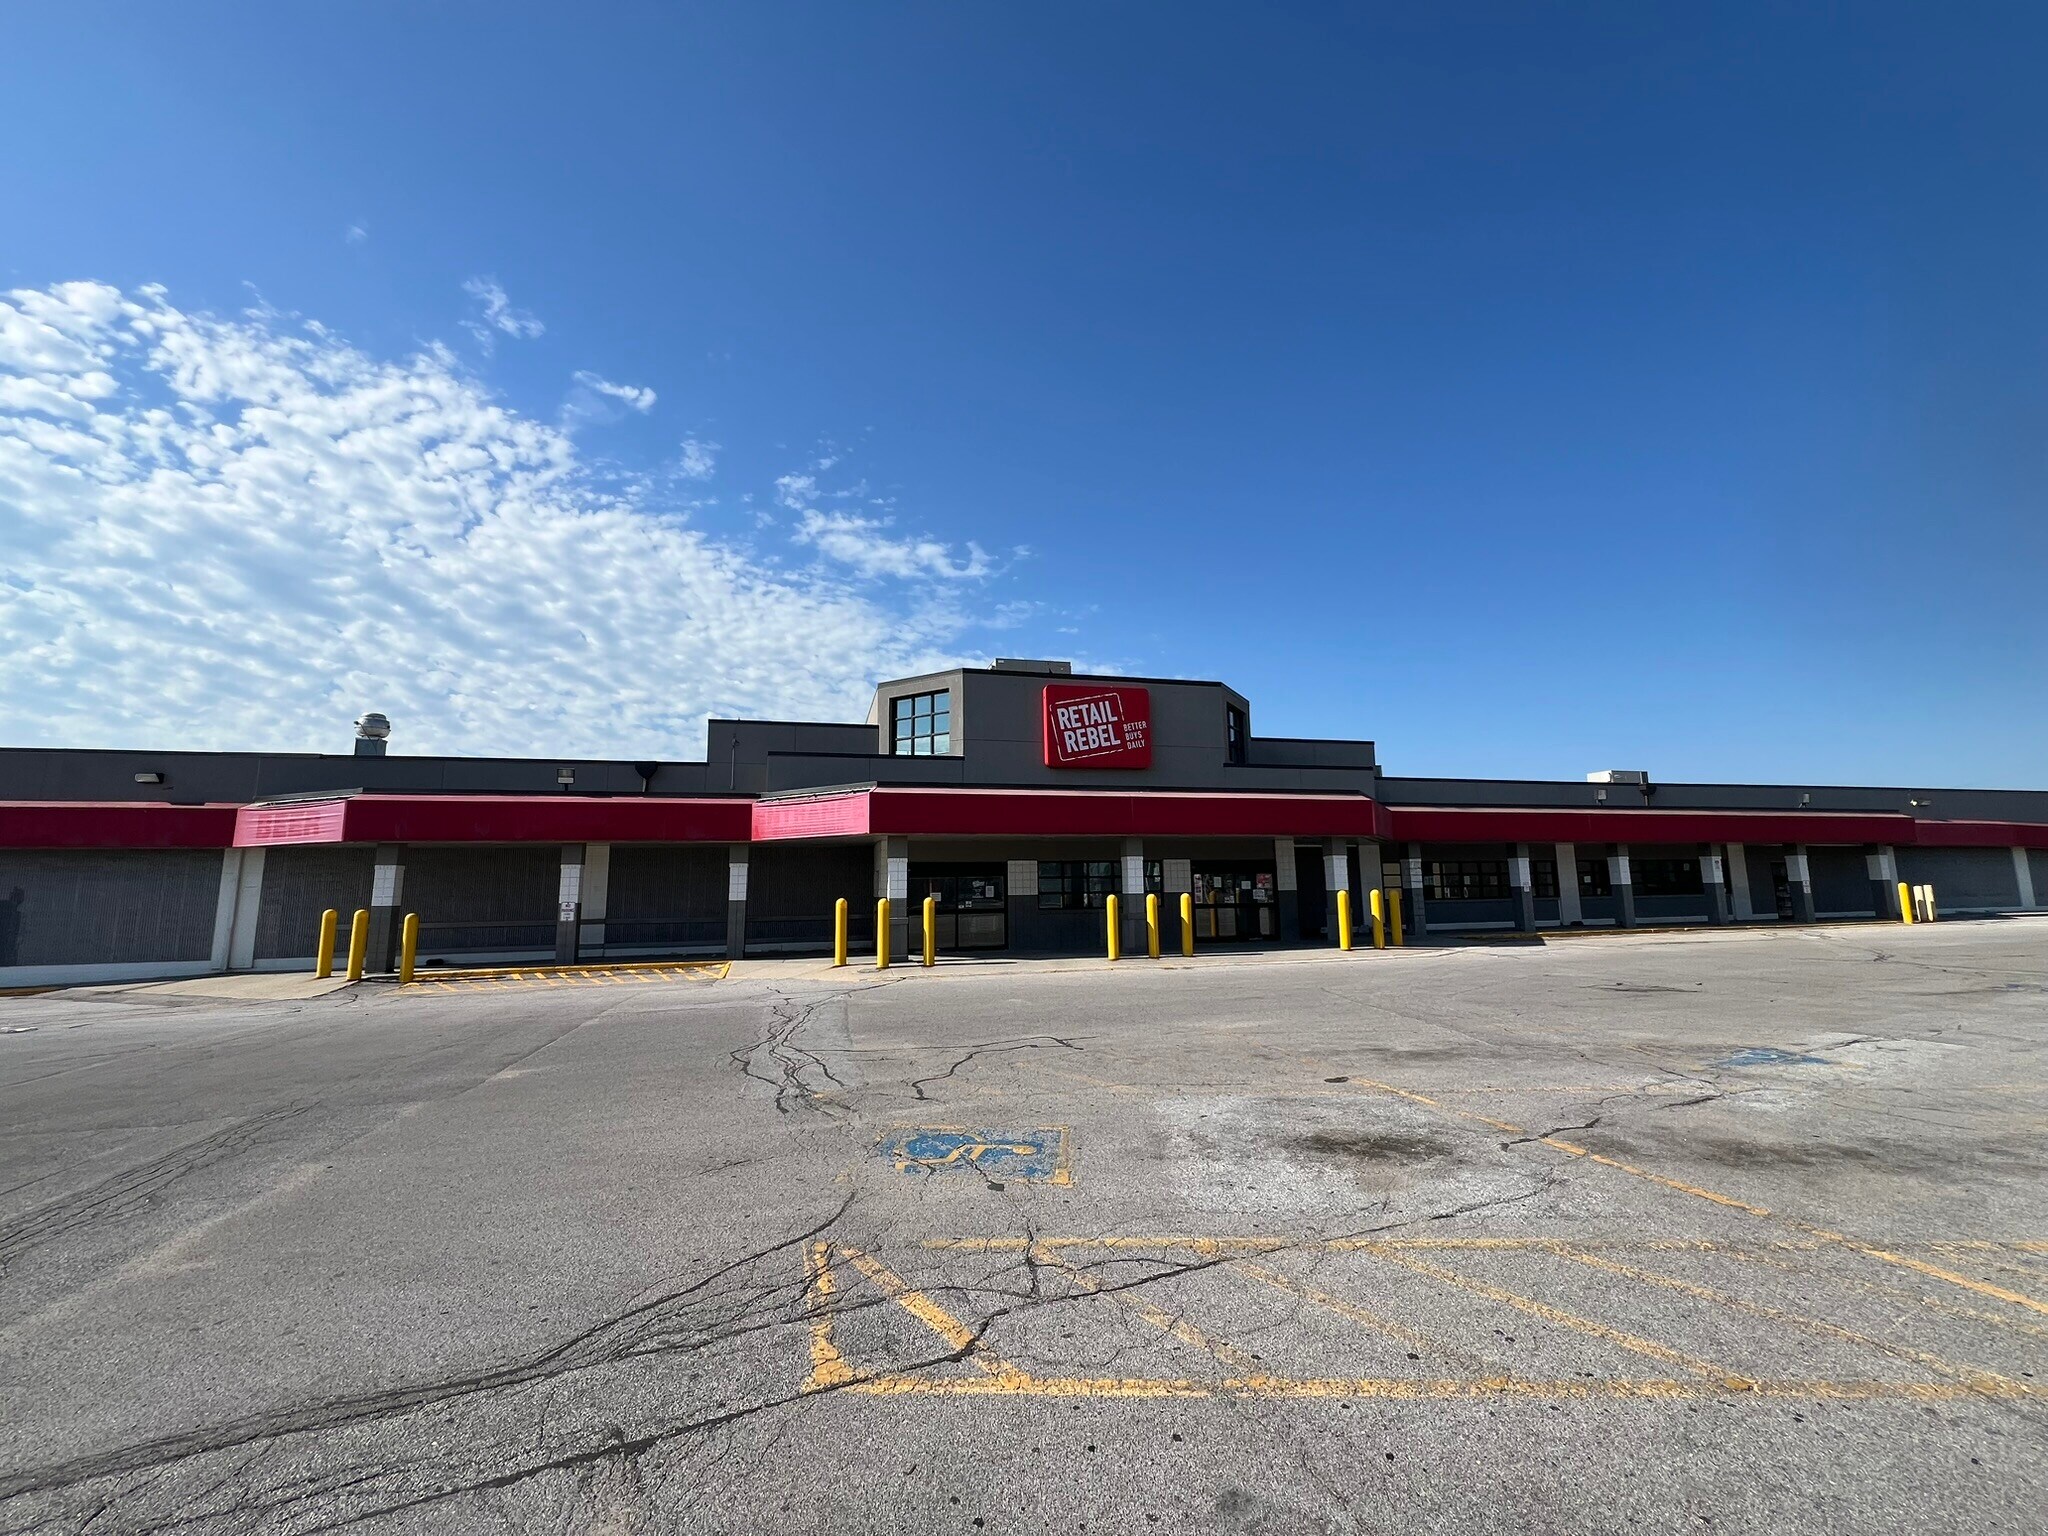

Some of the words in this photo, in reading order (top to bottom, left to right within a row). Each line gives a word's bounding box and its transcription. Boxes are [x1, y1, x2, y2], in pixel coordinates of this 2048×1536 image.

[1057, 700, 1118, 730] RETAIL
[1123, 721, 1147, 732] BETTER
[1064, 724, 1121, 753] REBEL
[1125, 731, 1143, 741] BUYS
[1127, 740, 1145, 750] DAILY
